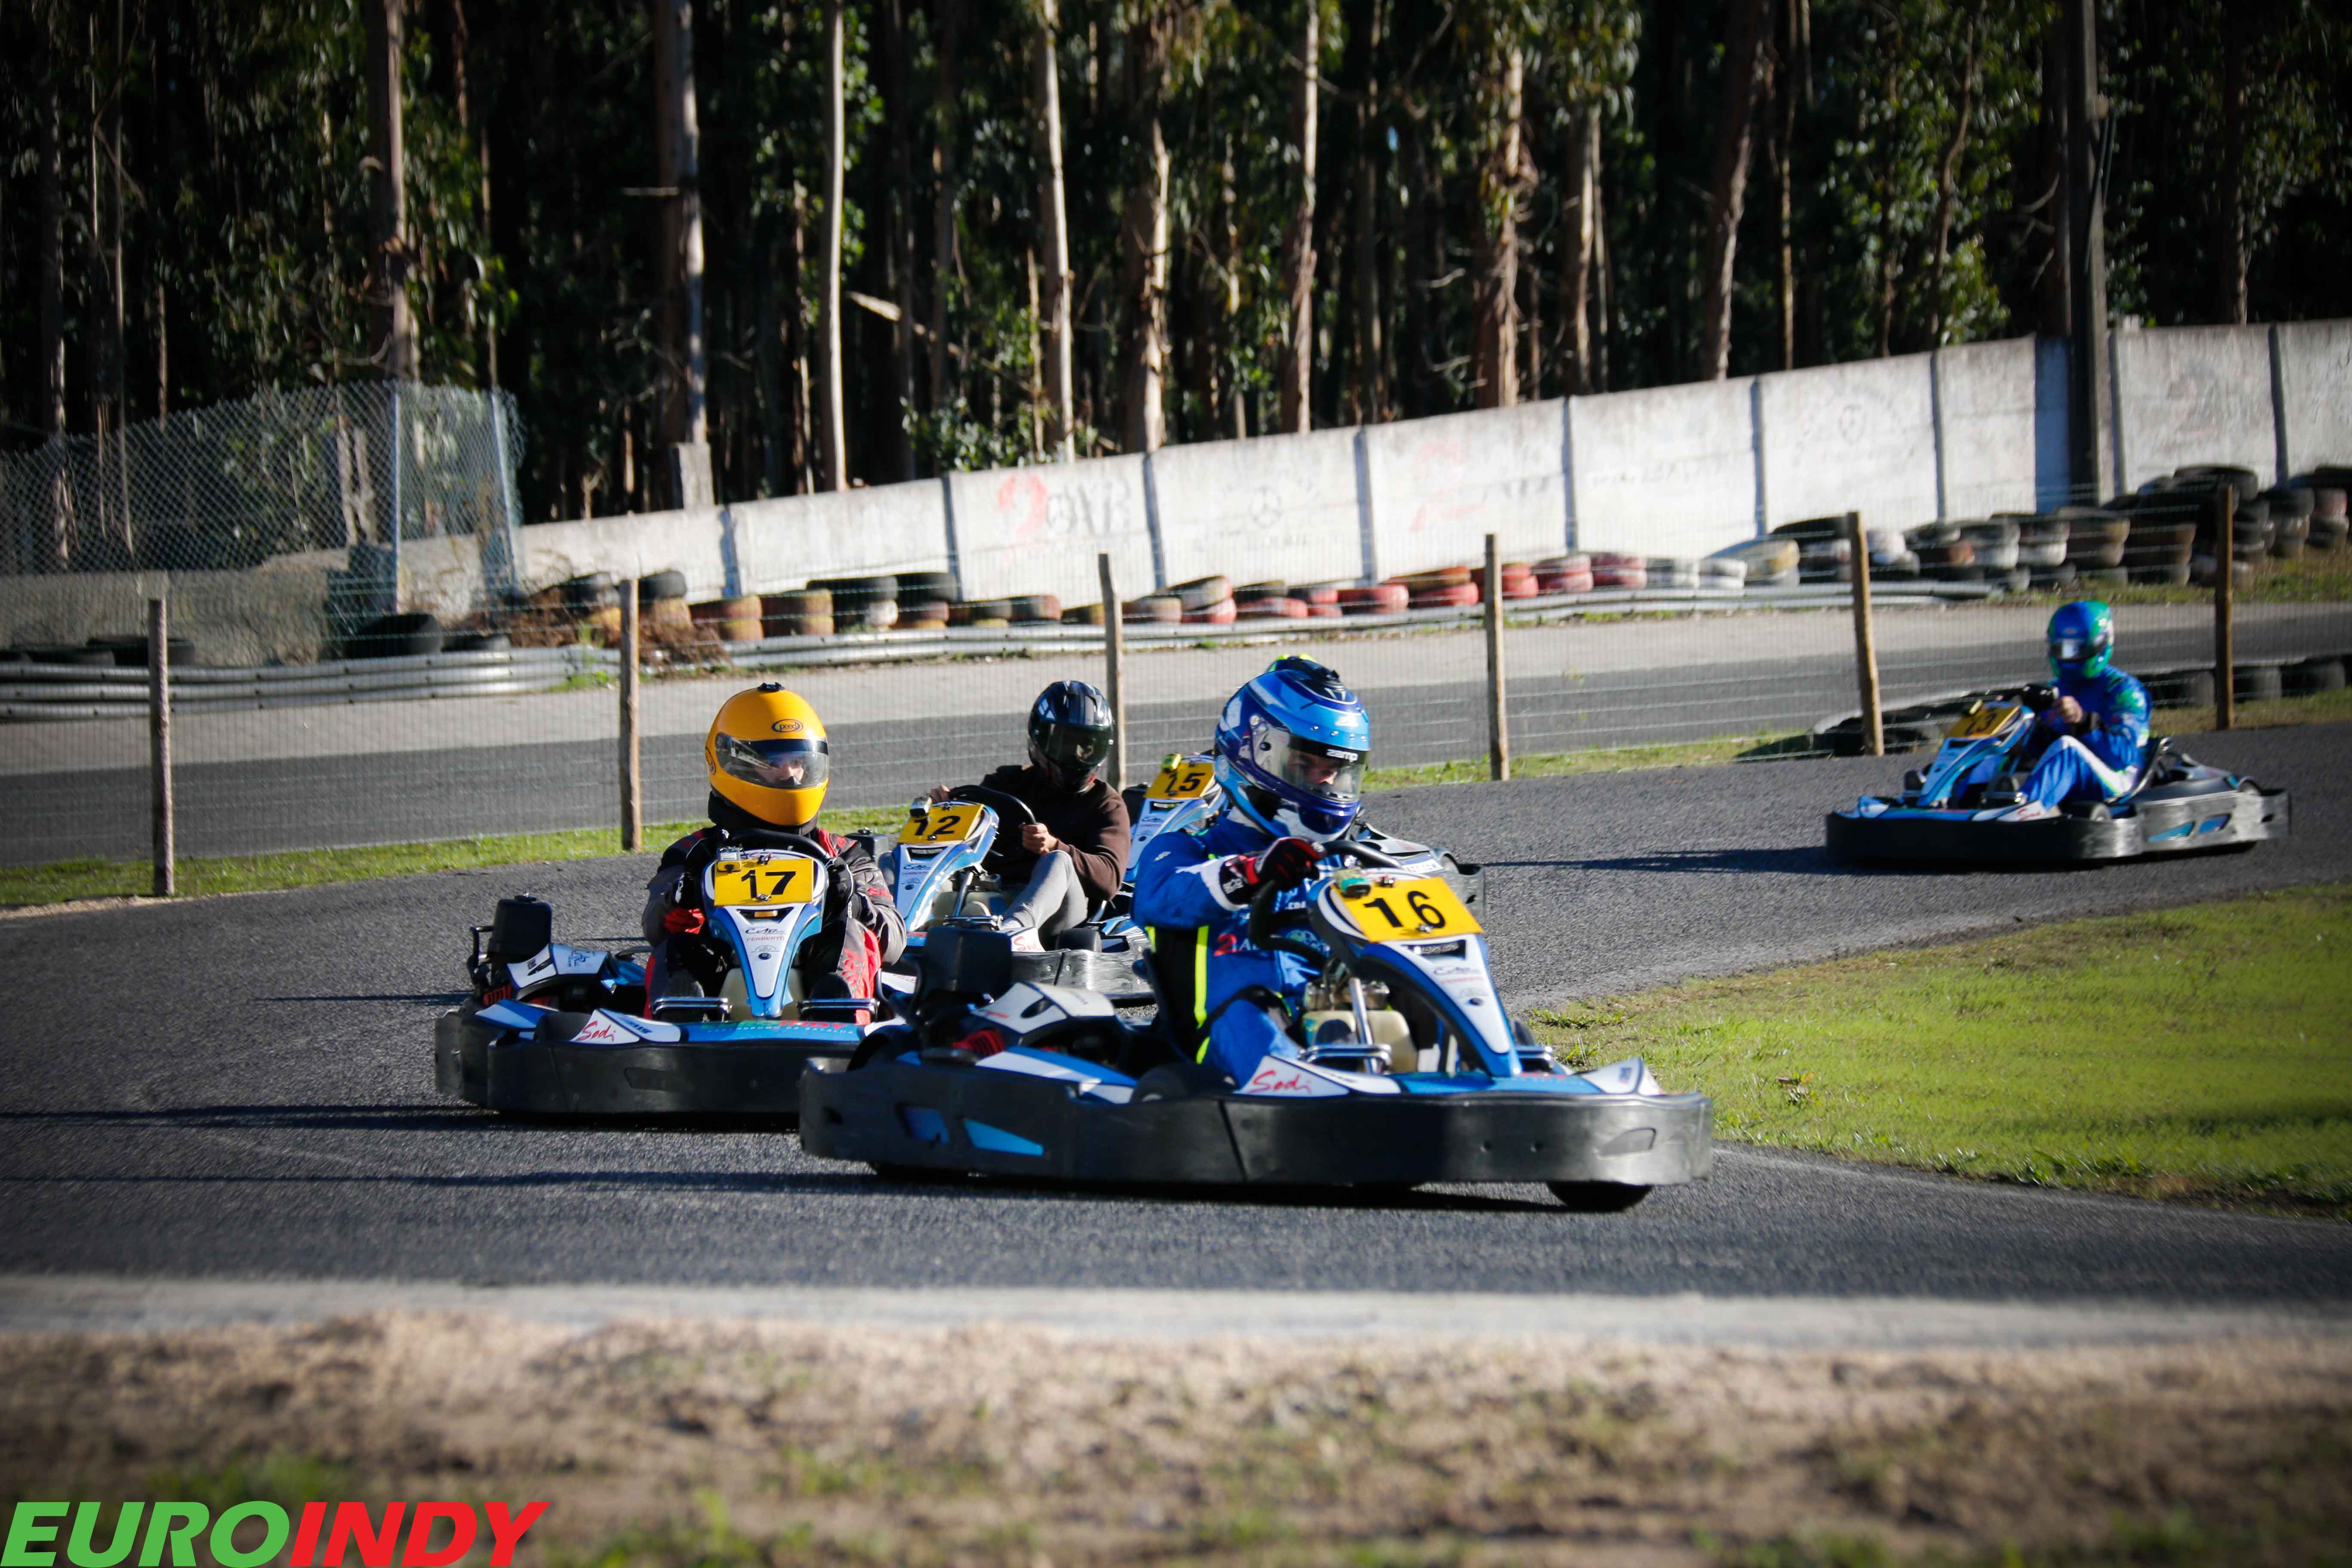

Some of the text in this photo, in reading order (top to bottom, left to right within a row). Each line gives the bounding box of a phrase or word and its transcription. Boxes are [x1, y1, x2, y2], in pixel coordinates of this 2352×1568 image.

[1165, 772, 1205, 793] 15
[913, 815, 961, 836] 12
[741, 870, 796, 899] 17
[1363, 891, 1446, 928] 16
[577, 1020, 616, 1042] Sodi
[1248, 1070, 1312, 1094] Sodi
